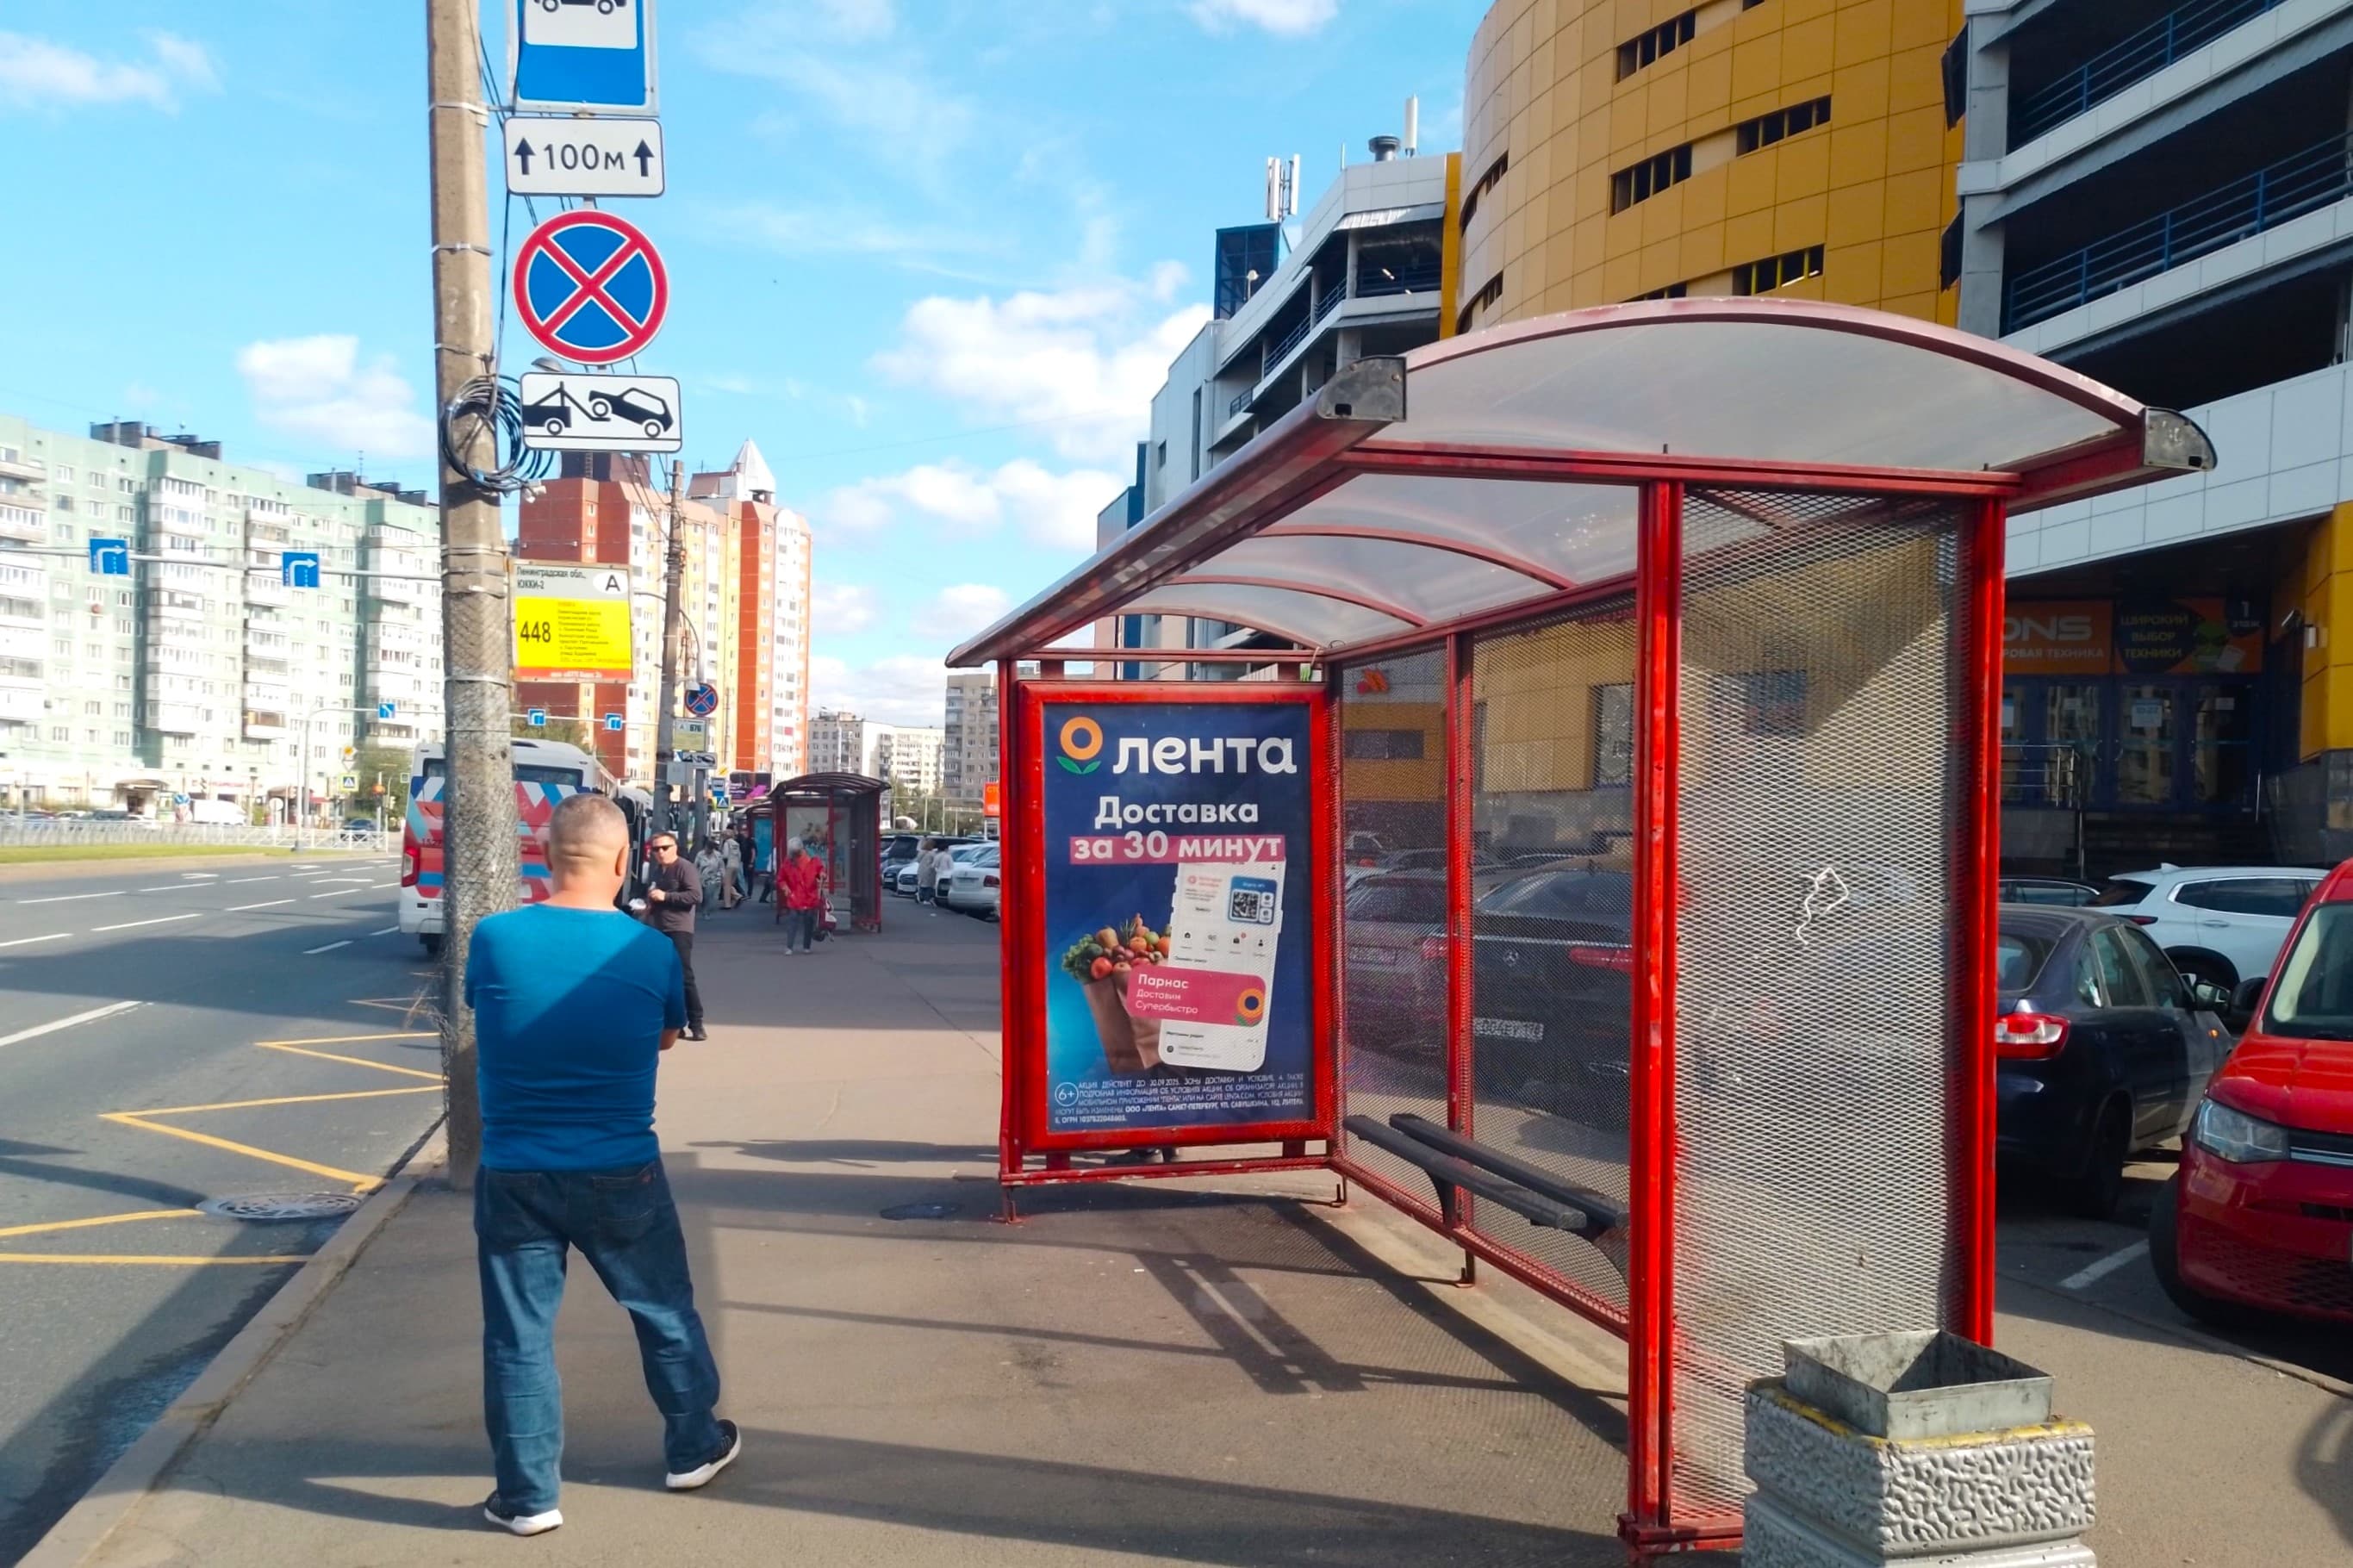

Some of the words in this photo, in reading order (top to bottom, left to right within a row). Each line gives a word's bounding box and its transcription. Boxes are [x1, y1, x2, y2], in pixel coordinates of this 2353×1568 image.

[605, 575, 620, 592] А
[2121, 613, 2188, 625] ШИРОКИЙ
[520, 620, 551, 643] 448
[2131, 632, 2176, 642] ВЫБОР
[2047, 648, 2104, 658] ТЕХНИКА
[2123, 648, 2182, 658] ТЕХНИКИ
[1112, 737, 1298, 775] лента
[1094, 796, 1259, 830] Доставка
[1074, 838, 1113, 859] за
[1124, 830, 1168, 859] 30
[1178, 837, 1281, 863] минут
[1138, 974, 1189, 989] Парнас
[1136, 999, 1198, 1014] Супербыстро
[1058, 1089, 1075, 1100] 6+
[1125, 1104, 1140, 1113] ООО
